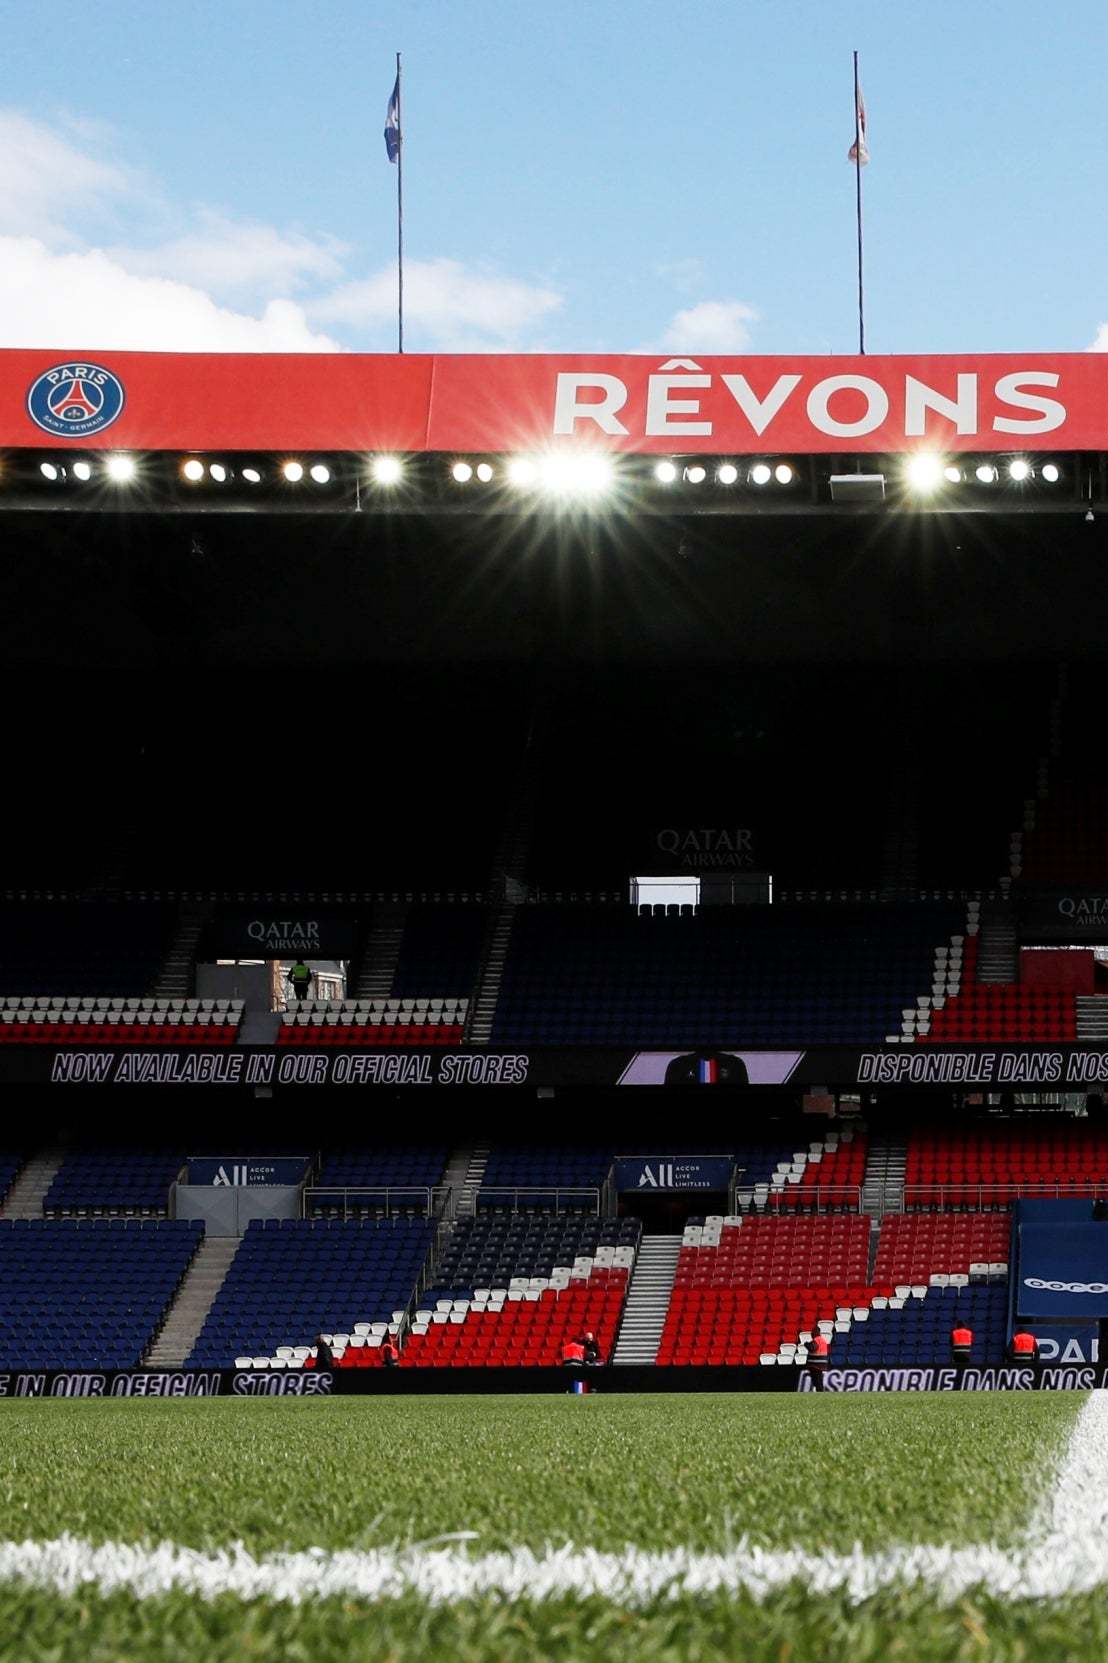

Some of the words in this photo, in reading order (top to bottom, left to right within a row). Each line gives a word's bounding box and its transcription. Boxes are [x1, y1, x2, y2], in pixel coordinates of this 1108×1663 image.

[46, 367, 108, 385] PARIS
[553, 358, 1067, 437] RÊVONS
[656, 829, 753, 855] QATAR
[247, 921, 320, 942] QATAR
[265, 939, 321, 949] AIRWAYS
[52, 1053, 114, 1082] NOW
[114, 1054, 243, 1083] AVAILABLE
[246, 1054, 275, 1083] IN
[279, 1054, 328, 1083] OUR
[332, 1055, 432, 1083] OFFICIAL
[438, 1055, 529, 1084] STORES
[857, 1053, 995, 1082] DISPONIBLE
[998, 1053, 1062, 1082] DANS
[15, 1374, 45, 1396] IN
[49, 1374, 106, 1396] OUR
[109, 1373, 221, 1396] OFFICIAL
[232, 1372, 334, 1396] STORES
[797, 1369, 957, 1392] DSPONIBLE
[959, 1369, 1034, 1391] DANS
[1039, 1368, 1096, 1391] NOS
